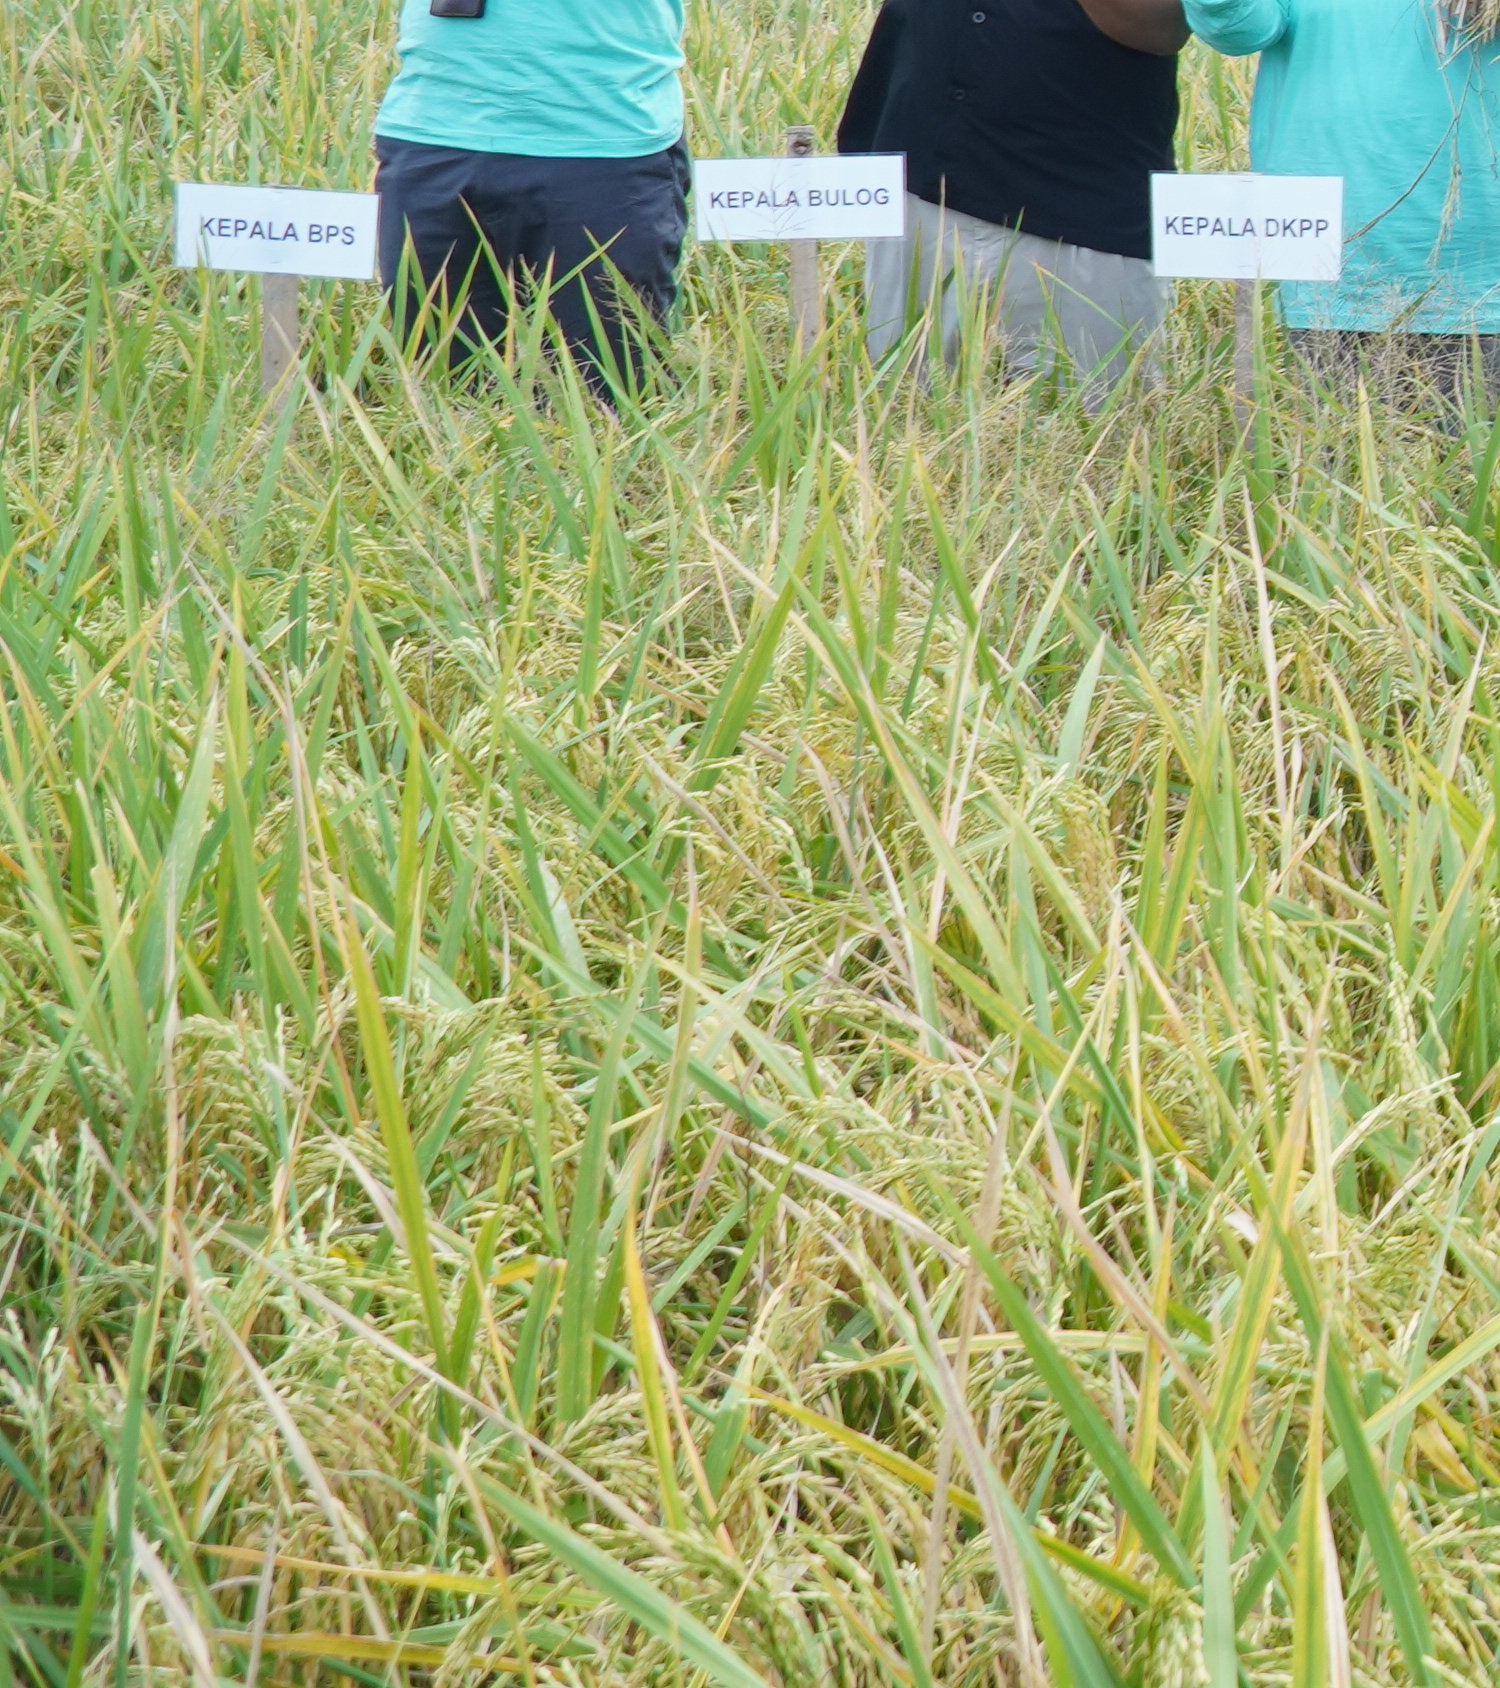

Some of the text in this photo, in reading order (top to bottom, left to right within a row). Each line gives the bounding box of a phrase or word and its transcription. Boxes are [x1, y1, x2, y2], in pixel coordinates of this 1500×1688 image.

[710, 188, 890, 209] KEPALA BULOG
[200, 217, 356, 246] KEPALA BPS
[1165, 216, 1329, 238] KEPALA DKPP
